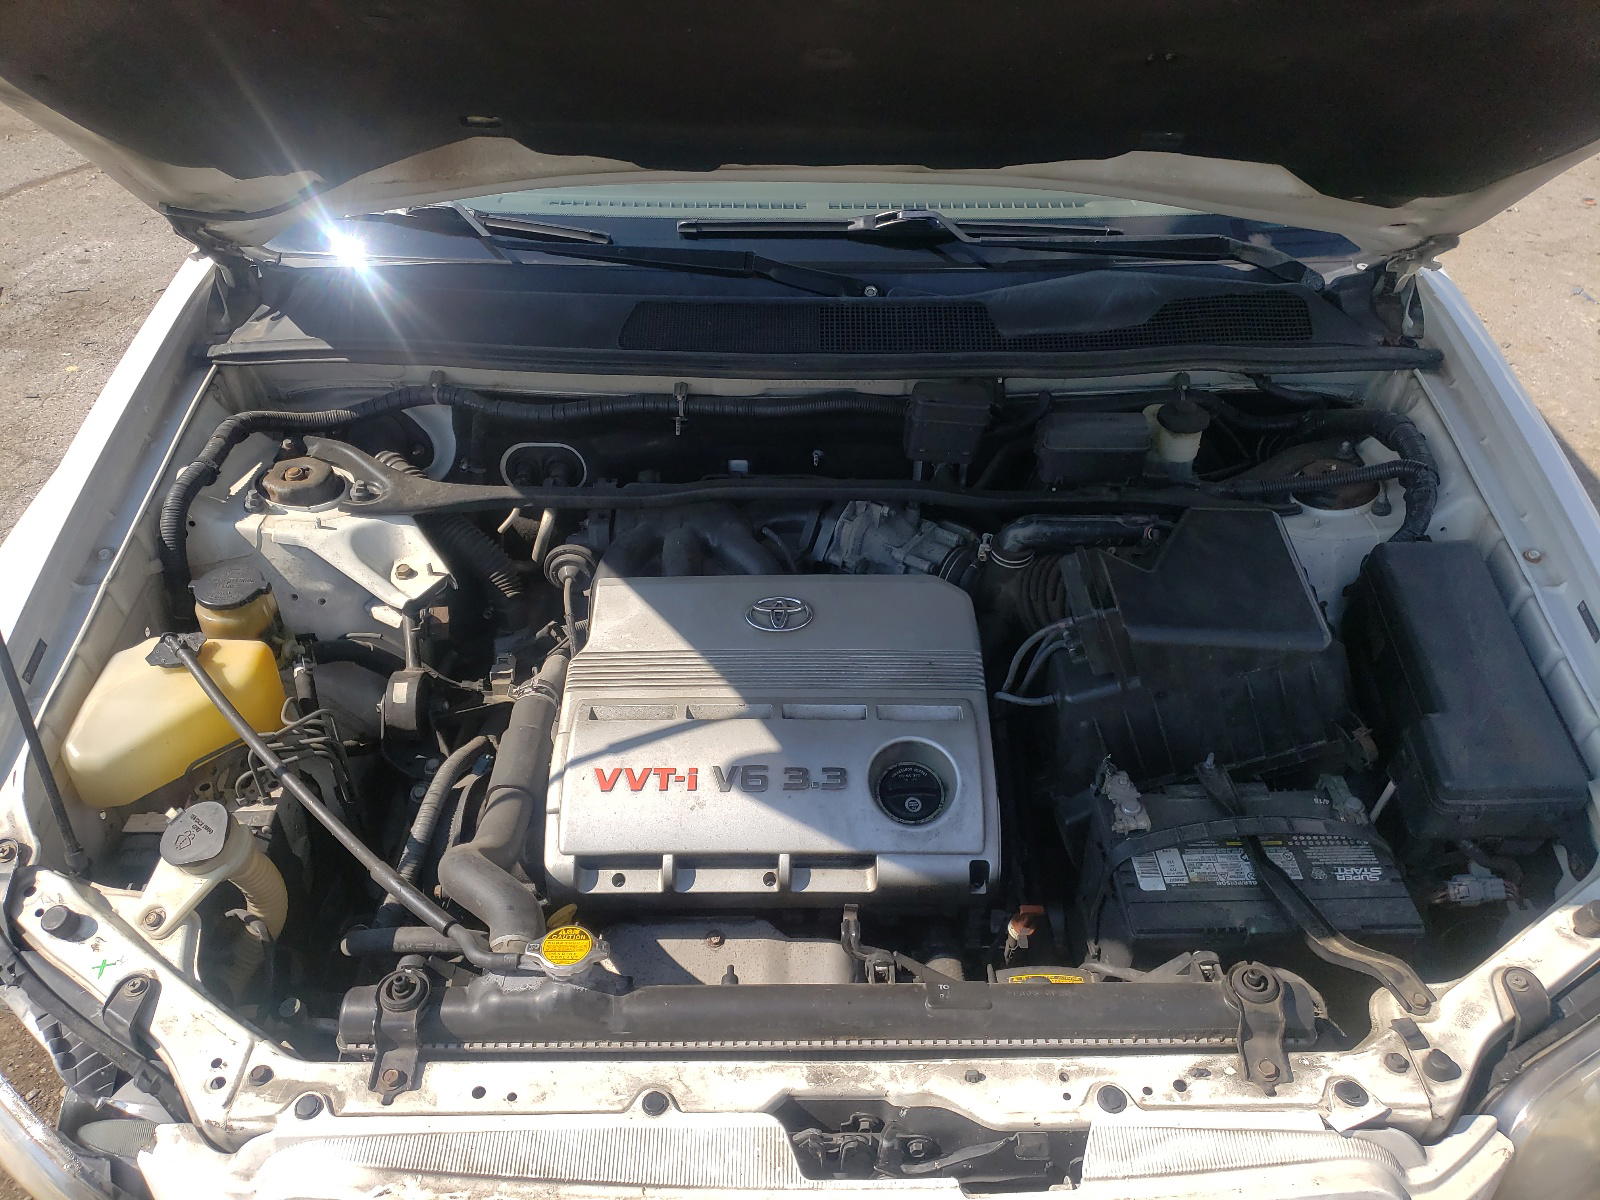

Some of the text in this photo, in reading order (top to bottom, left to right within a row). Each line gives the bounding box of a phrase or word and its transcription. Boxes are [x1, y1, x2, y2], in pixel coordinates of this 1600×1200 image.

[594, 764, 848, 792] VVT-i V6 3.3
[1334, 867, 1382, 875] START
[1336, 874, 1380, 882] SUPER
